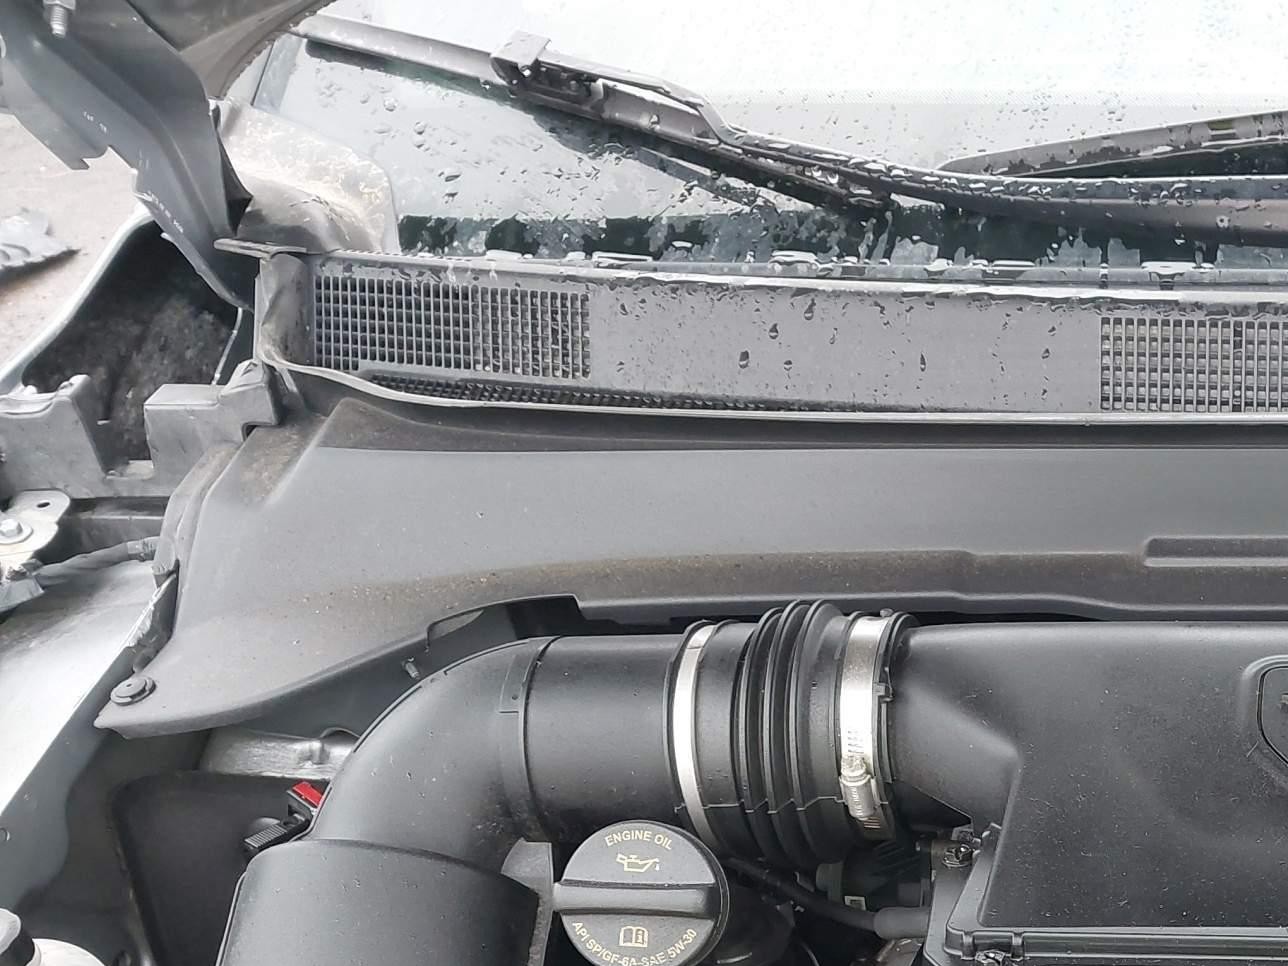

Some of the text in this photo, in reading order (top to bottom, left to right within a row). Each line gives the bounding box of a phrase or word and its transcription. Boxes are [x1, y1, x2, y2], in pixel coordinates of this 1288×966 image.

[604, 829, 673, 850] ENGINE OIL
[573, 921, 588, 942] API
[668, 928, 697, 958] 5W-30
